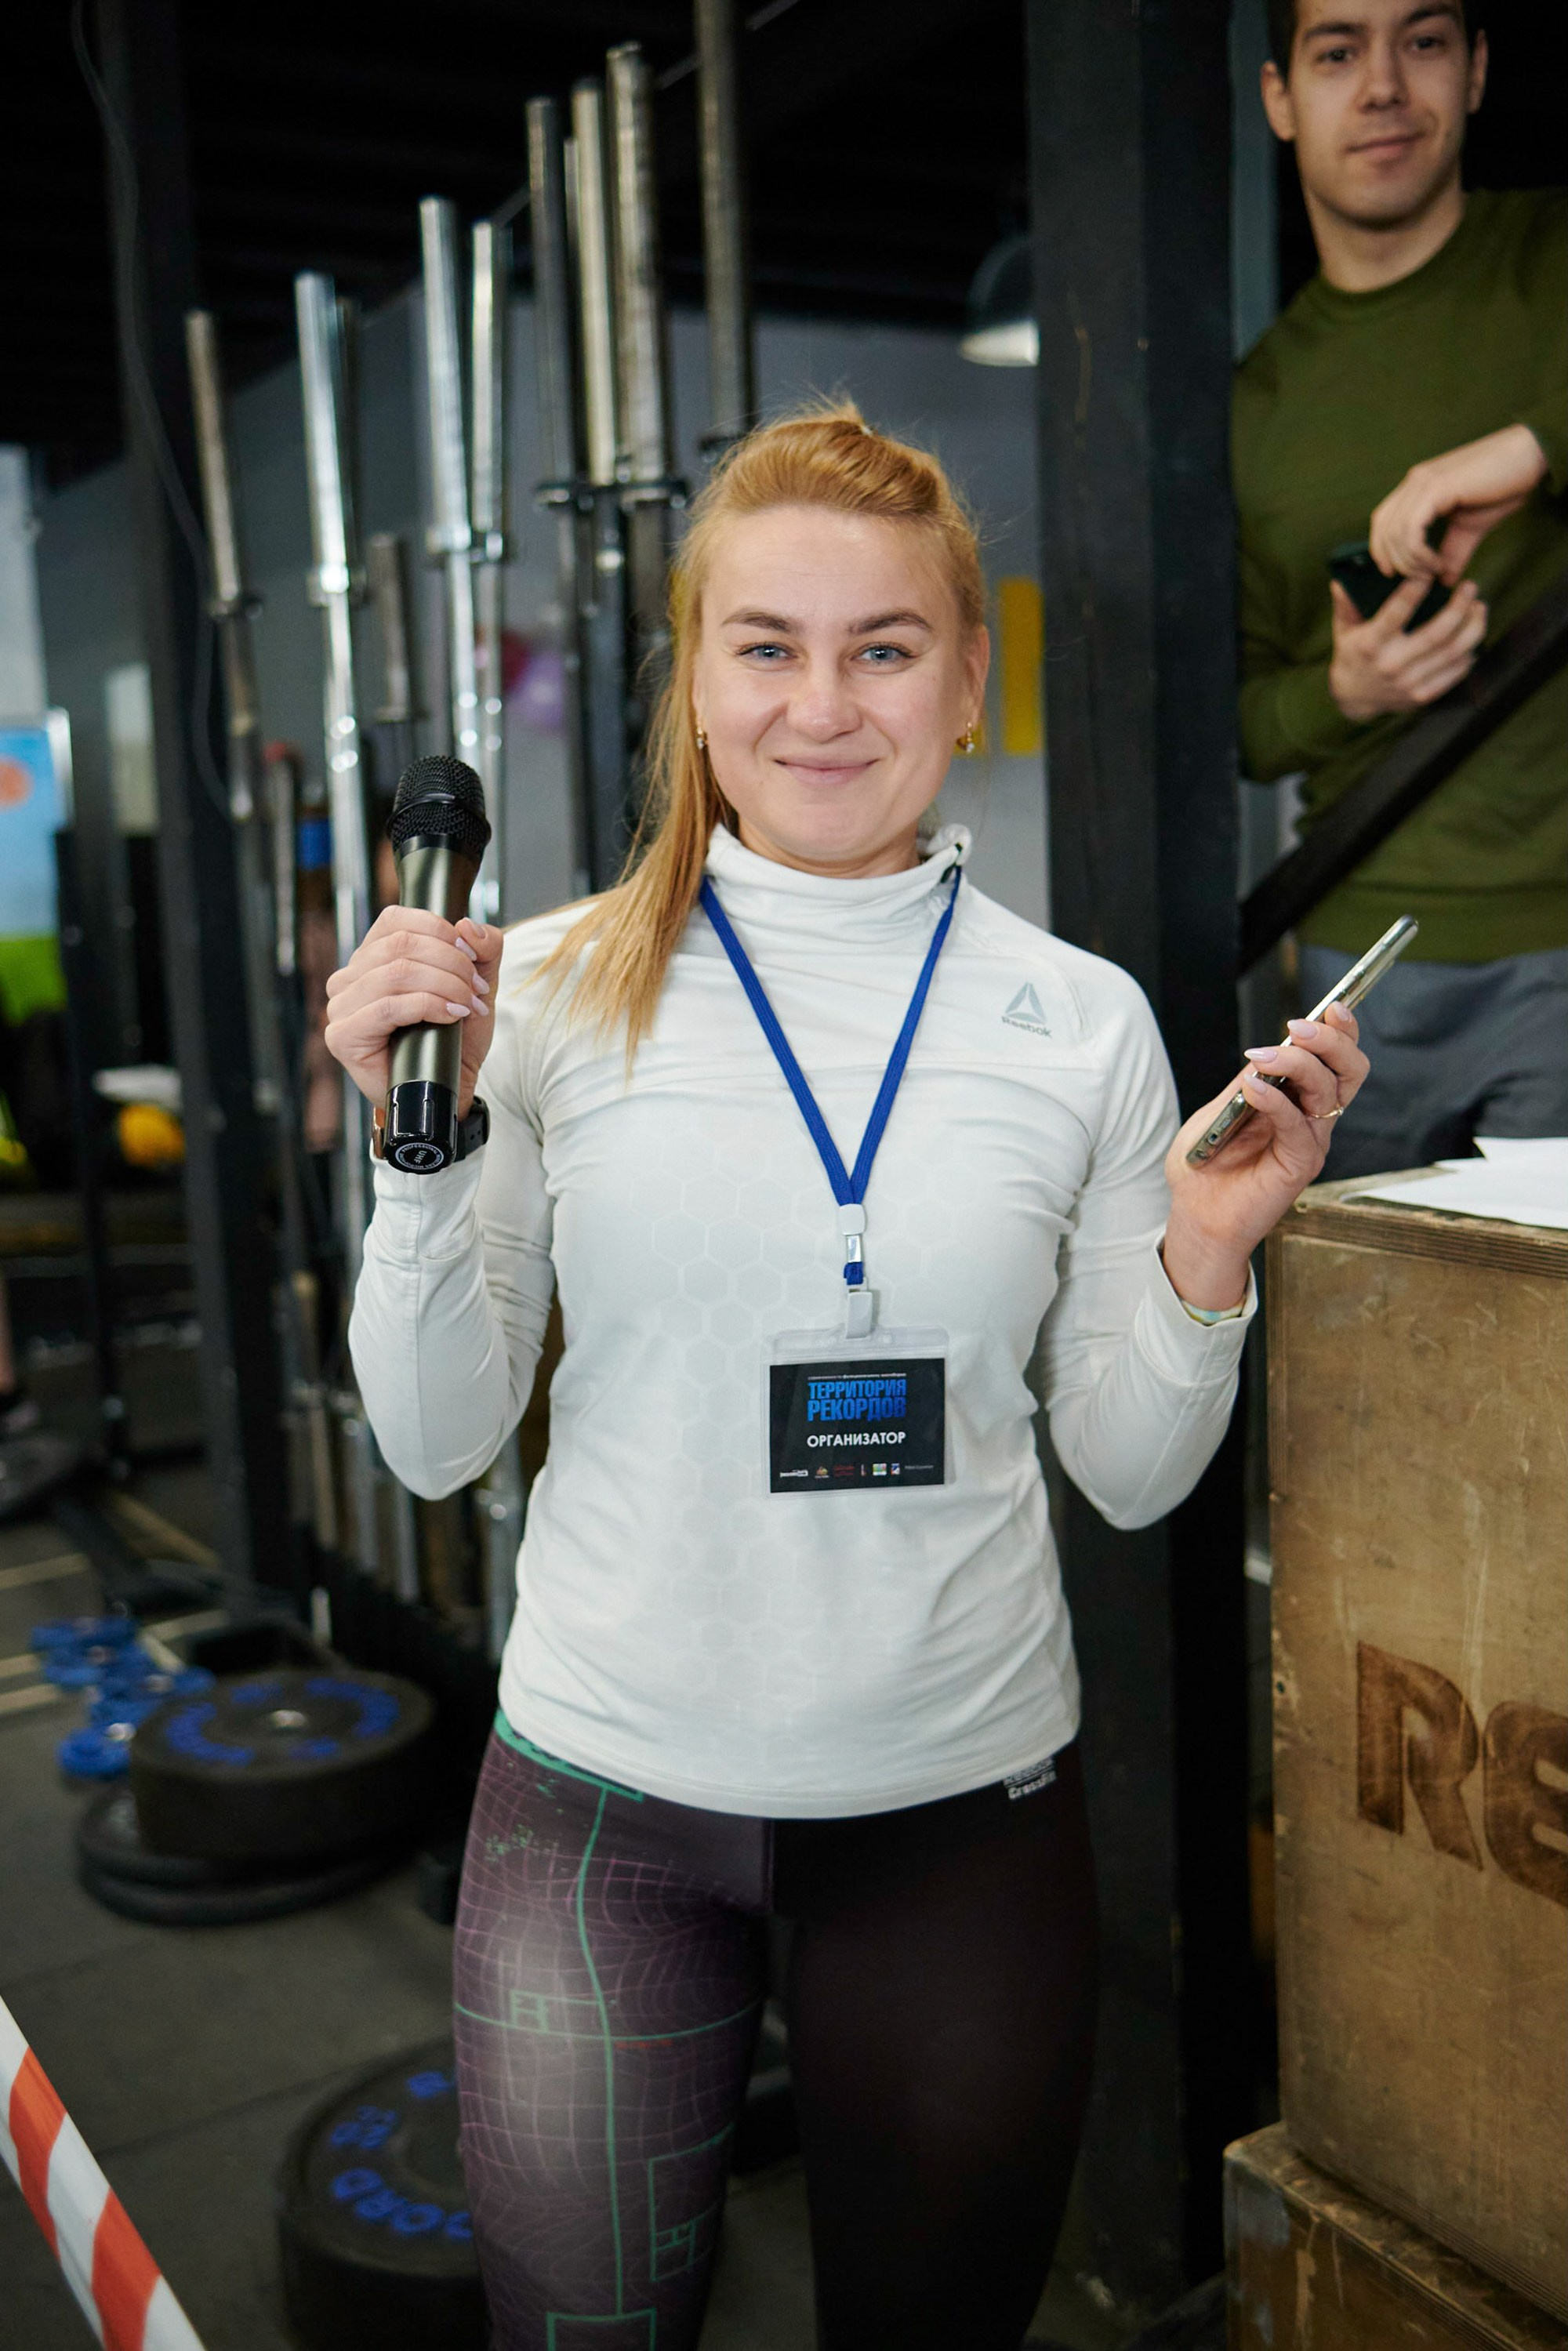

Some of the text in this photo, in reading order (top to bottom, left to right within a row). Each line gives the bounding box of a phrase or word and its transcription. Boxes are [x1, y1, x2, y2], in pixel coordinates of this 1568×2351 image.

[1001, 1015, 1052, 1039] Reebok
[413, 1150, 428, 1164] UHF
[808, 1378, 906, 1399] ТЕРРИТОРИЯ
[807, 1397, 906, 1422] РЕКОРДОВ
[807, 1431, 906, 1448] ОРГАНИЗАТОР
